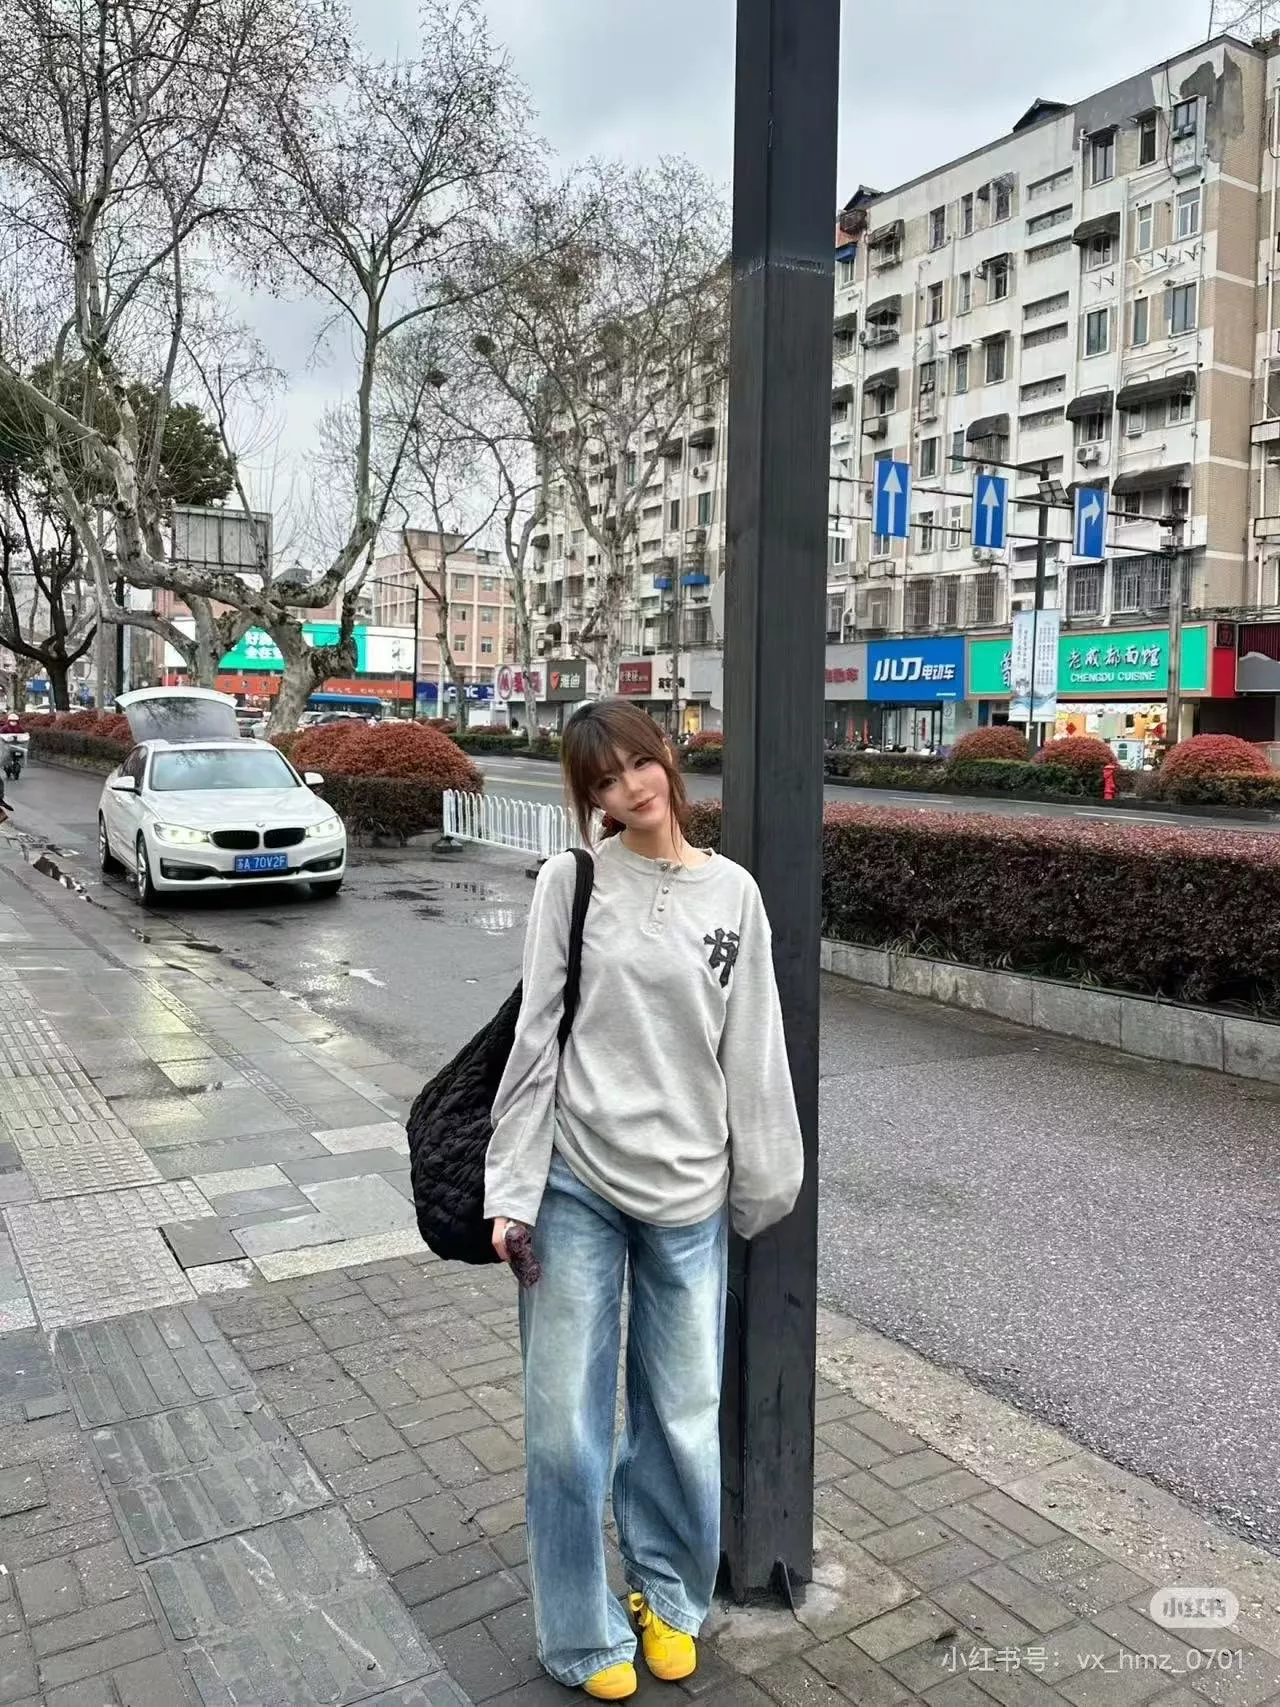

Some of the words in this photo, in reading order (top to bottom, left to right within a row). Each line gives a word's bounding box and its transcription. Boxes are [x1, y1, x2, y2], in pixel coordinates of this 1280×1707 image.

[873, 656, 956, 681] 小刀电动车
[1068, 645, 1160, 669] 老成都面馆
[1071, 671, 1114, 683] CHENGDU
[1117, 670, 1156, 681] CUISINE
